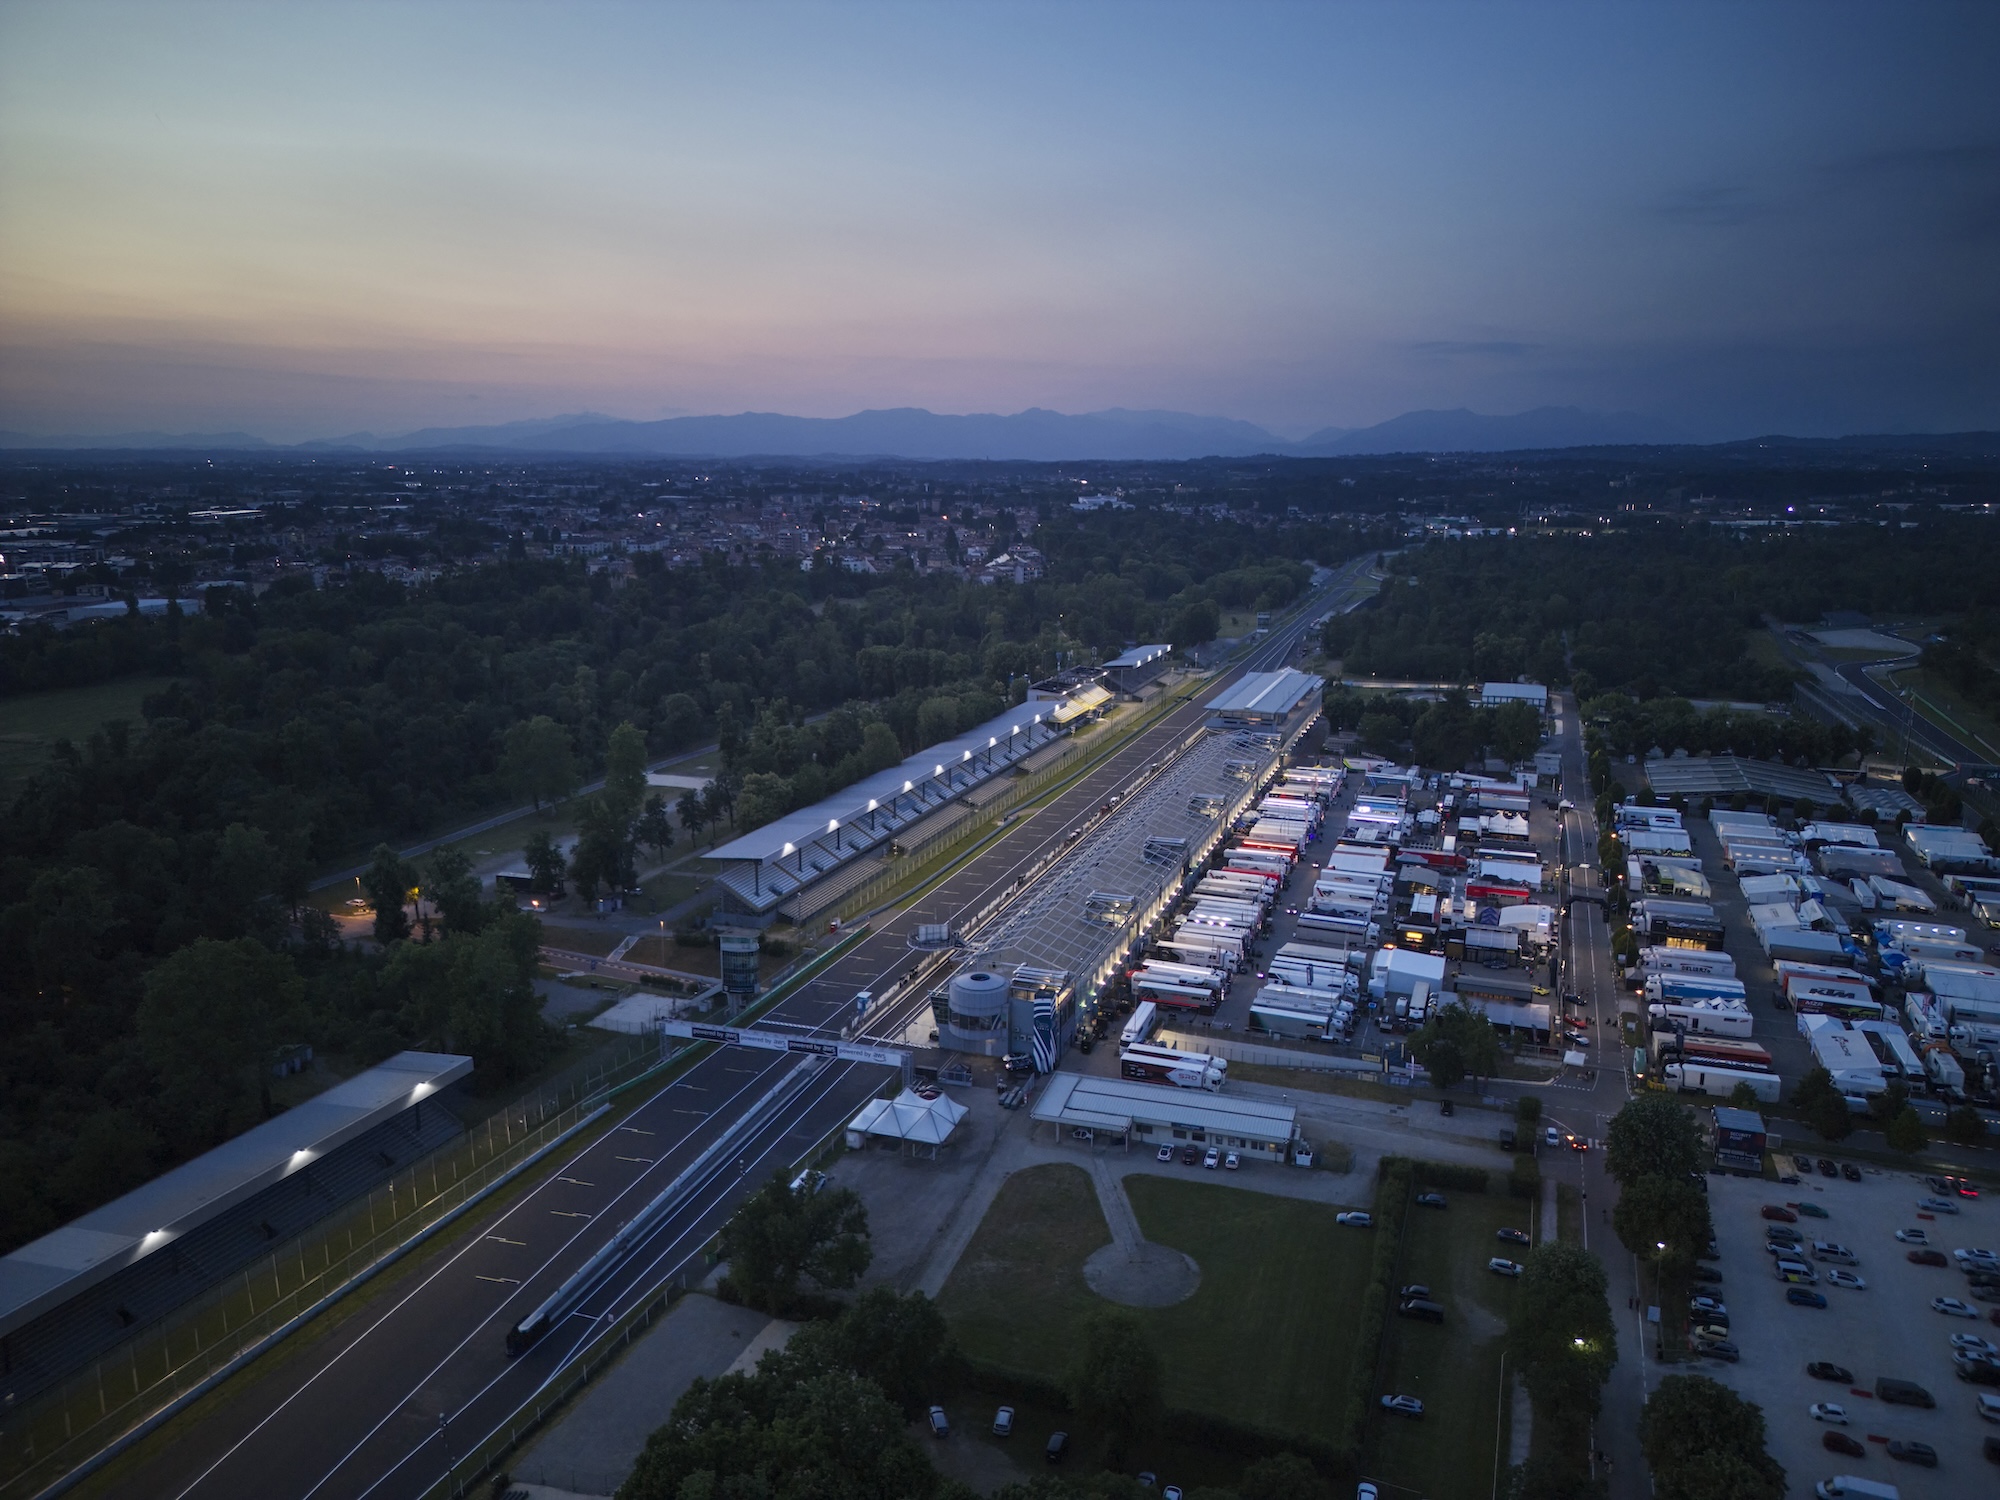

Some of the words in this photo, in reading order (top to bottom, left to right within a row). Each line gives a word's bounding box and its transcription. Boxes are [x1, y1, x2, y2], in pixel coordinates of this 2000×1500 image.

[1809, 987, 1855, 999] KTM
[692, 1029, 716, 1037] powered
[725, 1032, 738, 1042] aws
[740, 1034, 764, 1043] powered
[765, 1036, 772, 1044] by
[773, 1039, 786, 1048] aws
[789, 1042, 814, 1050] powered
[822, 1045, 836, 1055] aws
[839, 1048, 863, 1057] powered
[864, 1050, 871, 1058] by
[873, 1053, 886, 1062] aws
